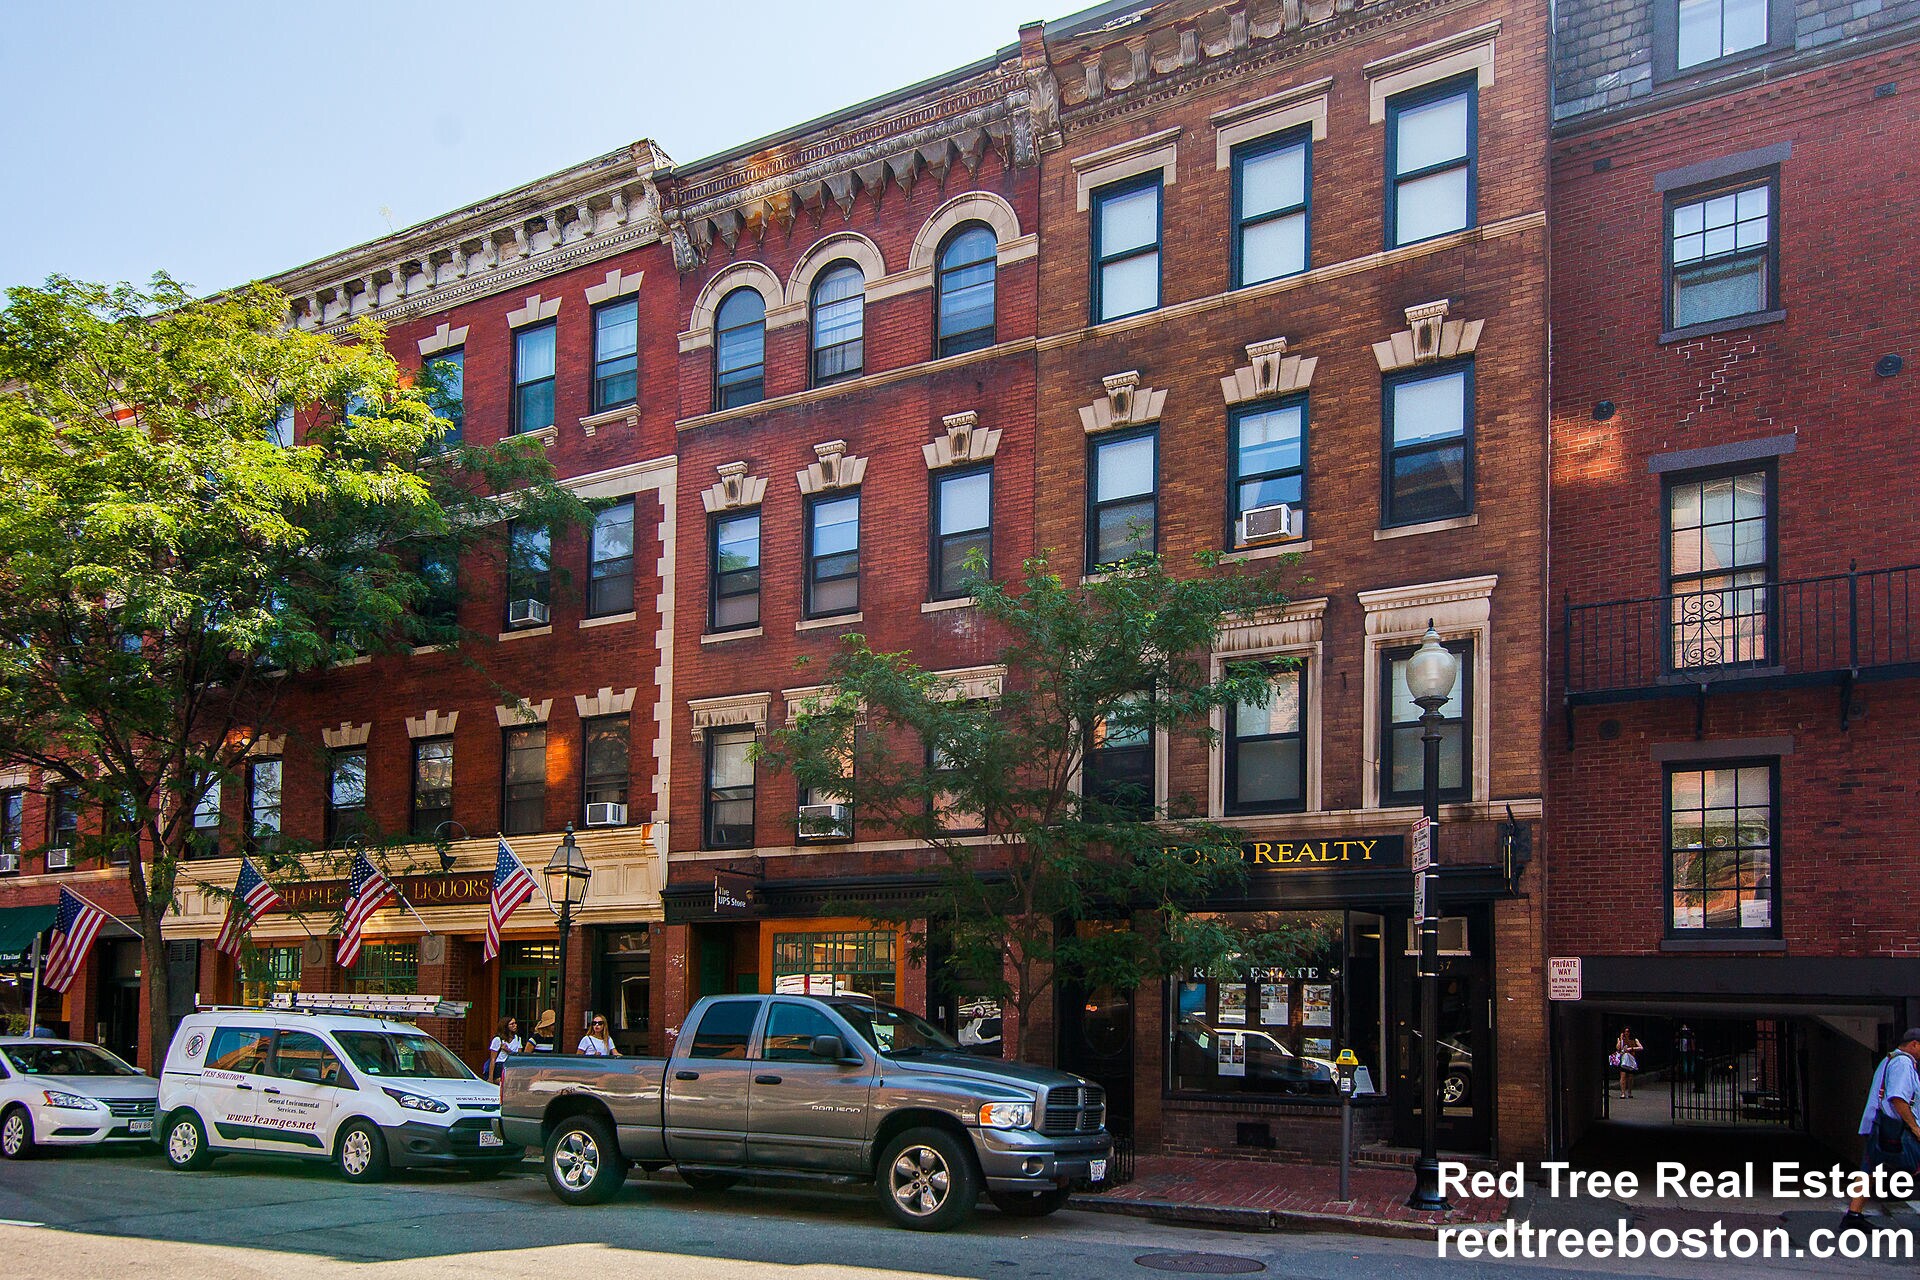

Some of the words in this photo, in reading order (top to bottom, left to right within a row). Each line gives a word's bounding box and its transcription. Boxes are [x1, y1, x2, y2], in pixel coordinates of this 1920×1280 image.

[1253, 840, 1378, 864] REALTY
[414, 879, 490, 902] LIQUORS
[718, 886, 730, 896] The
[718, 896, 731, 906] UPS
[731, 898, 746, 908] Store
[1250, 966, 1319, 979] ESTATE
[203, 1070, 218, 1079] PEST
[217, 1072, 246, 1081] SOLUTIONS
[268, 1097, 285, 1106] General
[285, 1100, 320, 1109] Environmental
[226, 1113, 317, 1131] www.Teamges.net
